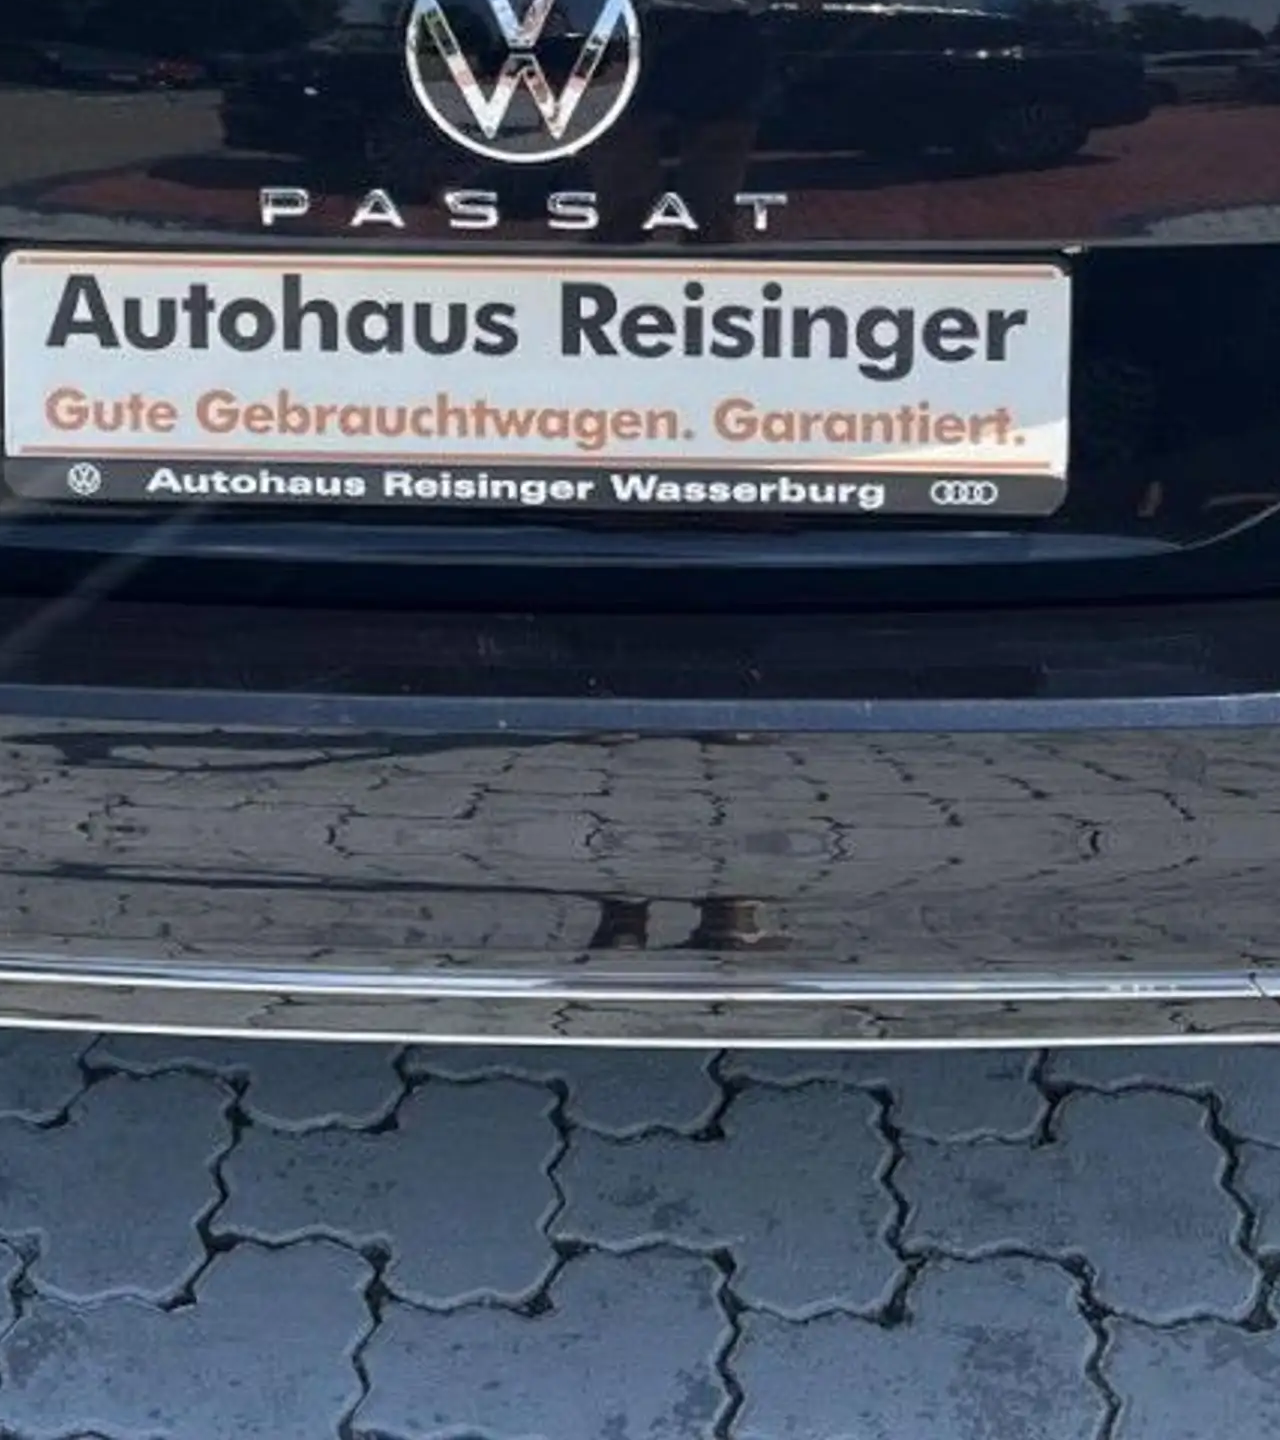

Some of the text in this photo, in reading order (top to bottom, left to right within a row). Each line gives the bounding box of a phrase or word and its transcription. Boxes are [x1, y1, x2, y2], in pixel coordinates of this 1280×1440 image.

[259, 186, 789, 232] PASSAT
[45, 273, 1028, 382] Autohaus Reisinger
[45, 385, 1027, 451] Gute Gebrauchtwagen. Garantiert.
[146, 467, 886, 508] Autohaus Reisinger Wasserburg
